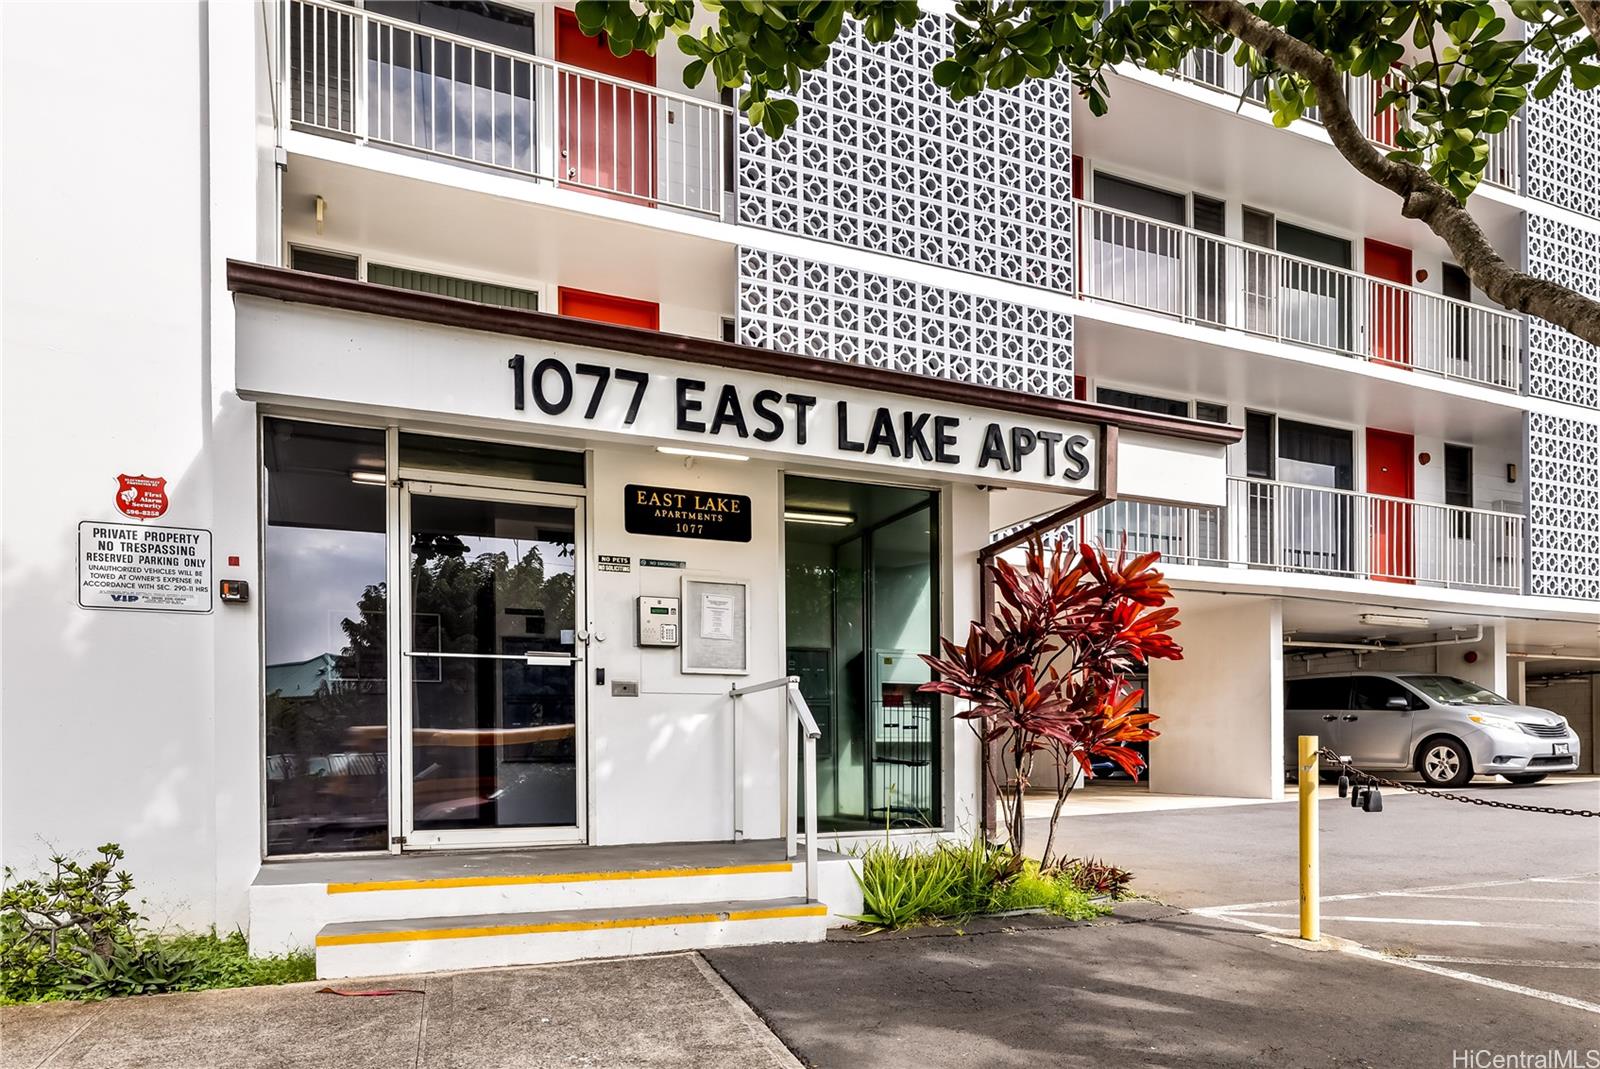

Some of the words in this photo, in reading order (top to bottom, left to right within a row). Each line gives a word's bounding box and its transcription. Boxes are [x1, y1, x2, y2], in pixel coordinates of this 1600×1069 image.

[508, 354, 649, 426] 1077
[676, 378, 816, 446] EAST
[837, 400, 961, 464] LAKE
[978, 423, 1092, 481] APTS
[132, 502, 161, 510] Security
[637, 490, 686, 508] EAST
[695, 496, 740, 513] LAKE
[654, 509, 723, 522] APARTMENTS
[676, 523, 703, 534] 1077
[93, 527, 138, 540] PRIVATE
[144, 531, 200, 544] PROPERTY
[98, 540, 114, 551] NO
[120, 542, 196, 556] TRESPASSING
[86, 552, 133, 564] RESERVED
[139, 555, 179, 566] PARKING
[184, 558, 206, 568] ONLY
[88, 565, 142, 573] UNAUTHORIZED
[90, 572, 116, 580] TOWED
[83, 580, 135, 589] ACCORDANCE
[110, 594, 139, 602] VIP
